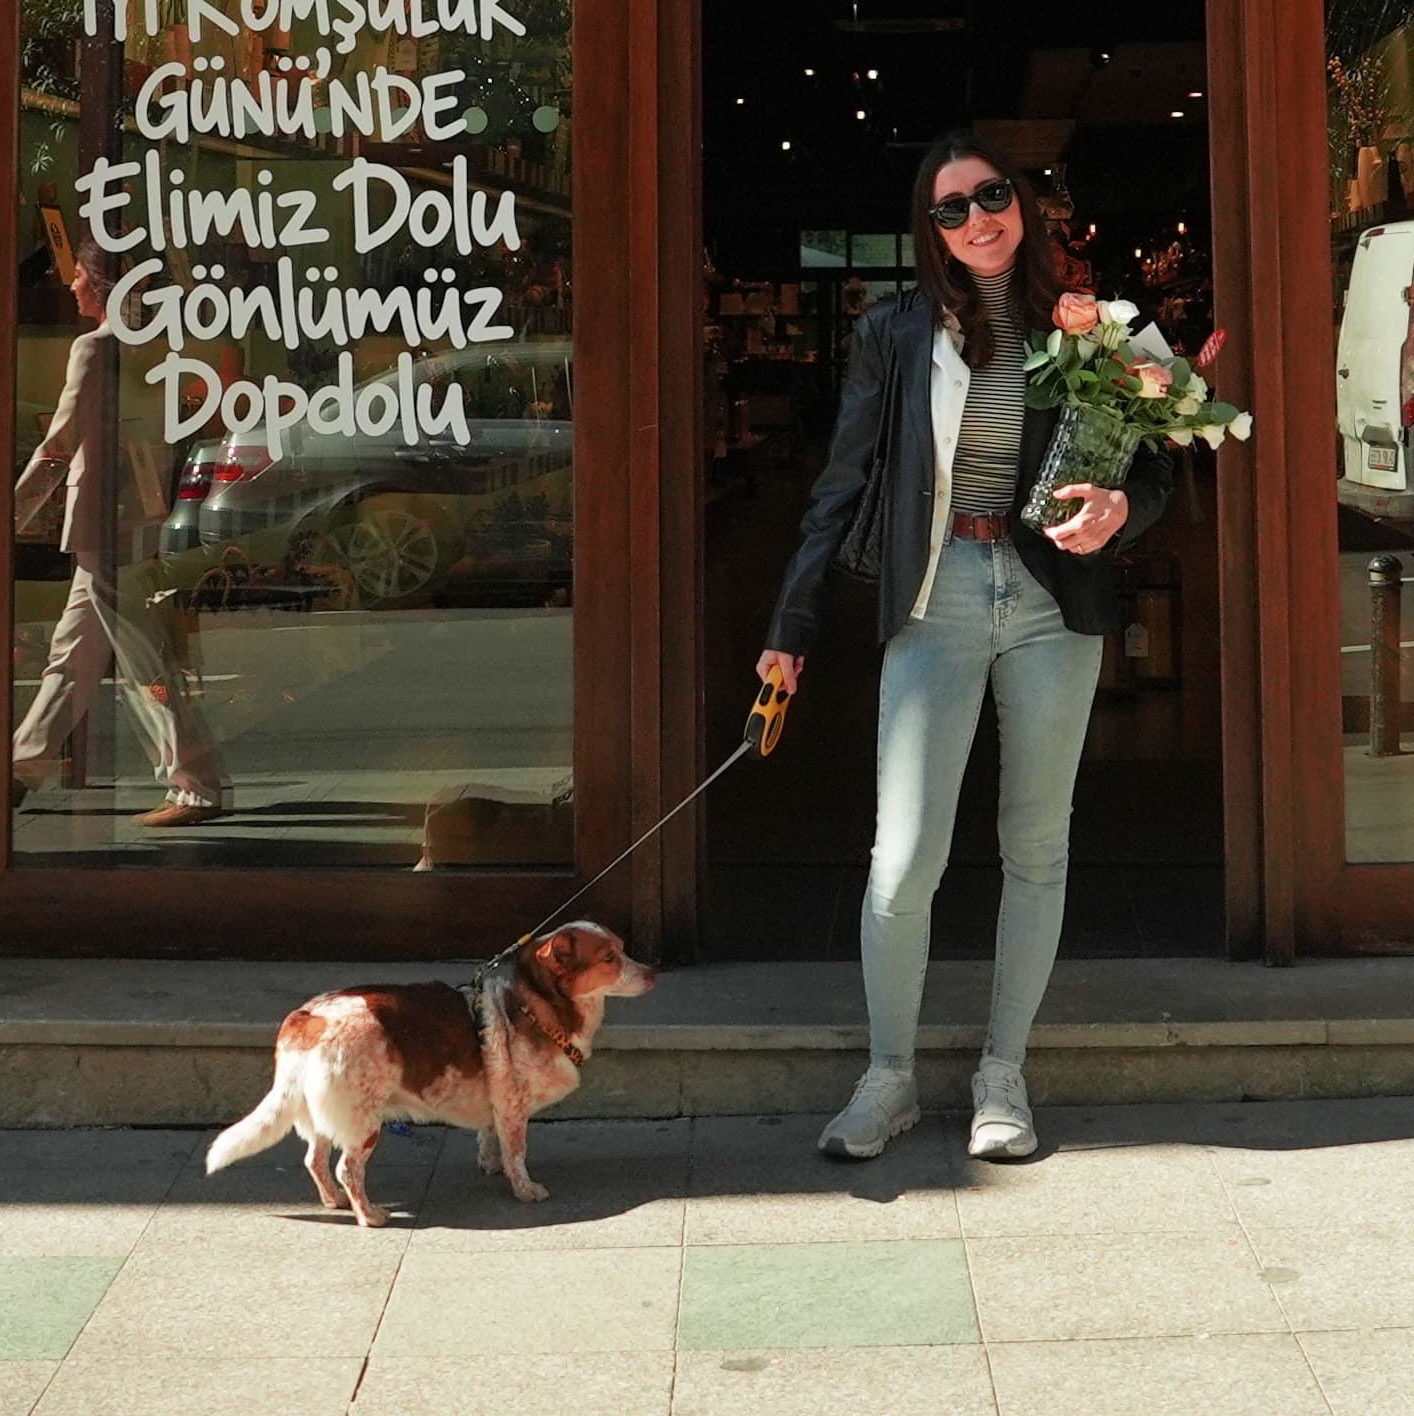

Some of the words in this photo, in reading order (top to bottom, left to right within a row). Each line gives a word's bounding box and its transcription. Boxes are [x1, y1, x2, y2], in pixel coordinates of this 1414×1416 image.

[74, 148, 331, 253] Elimiz
[332, 154, 521, 256] Dolu
[105, 256, 515, 352] Gönlümüz
[145, 351, 471, 463] Dopdolu
